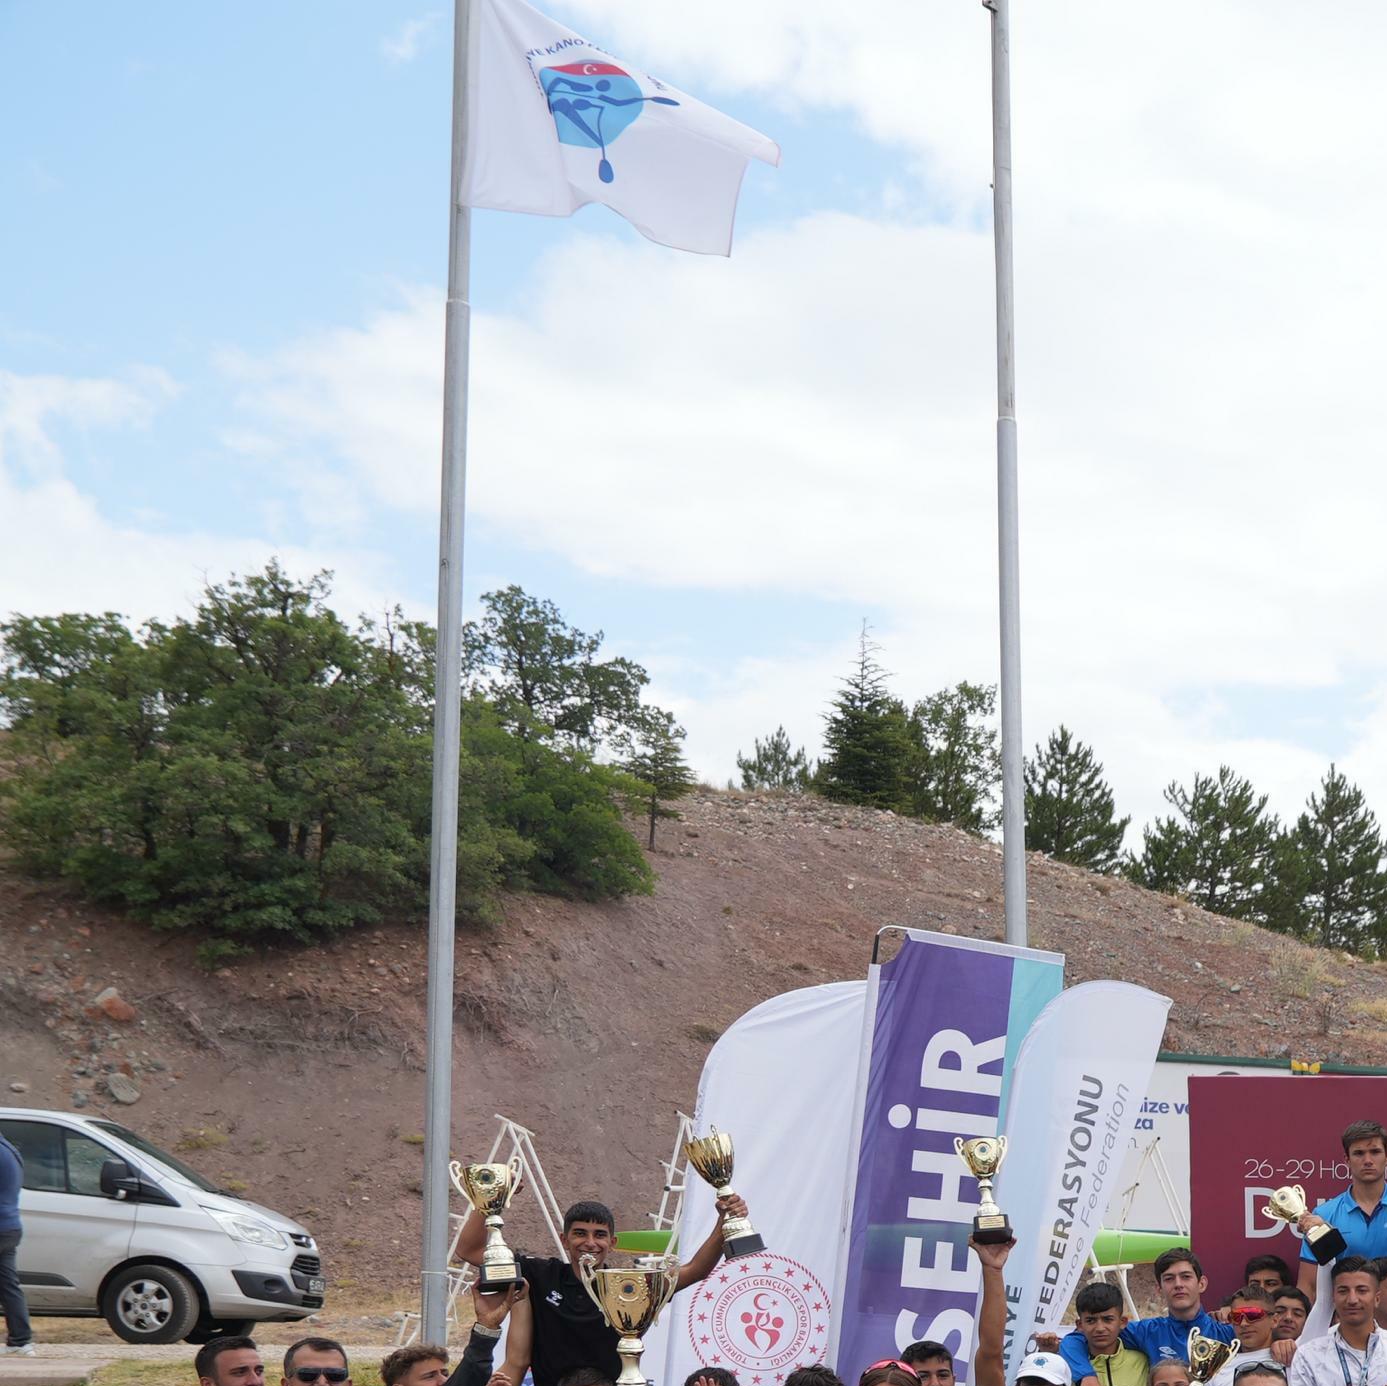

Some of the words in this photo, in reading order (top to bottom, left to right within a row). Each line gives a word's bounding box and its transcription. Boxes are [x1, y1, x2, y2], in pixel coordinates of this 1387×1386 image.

[1034, 1074, 1104, 1325] FEDERASYONU
[1080, 1083, 1129, 1229] Federation
[1244, 1158, 1315, 1179] 26-29
